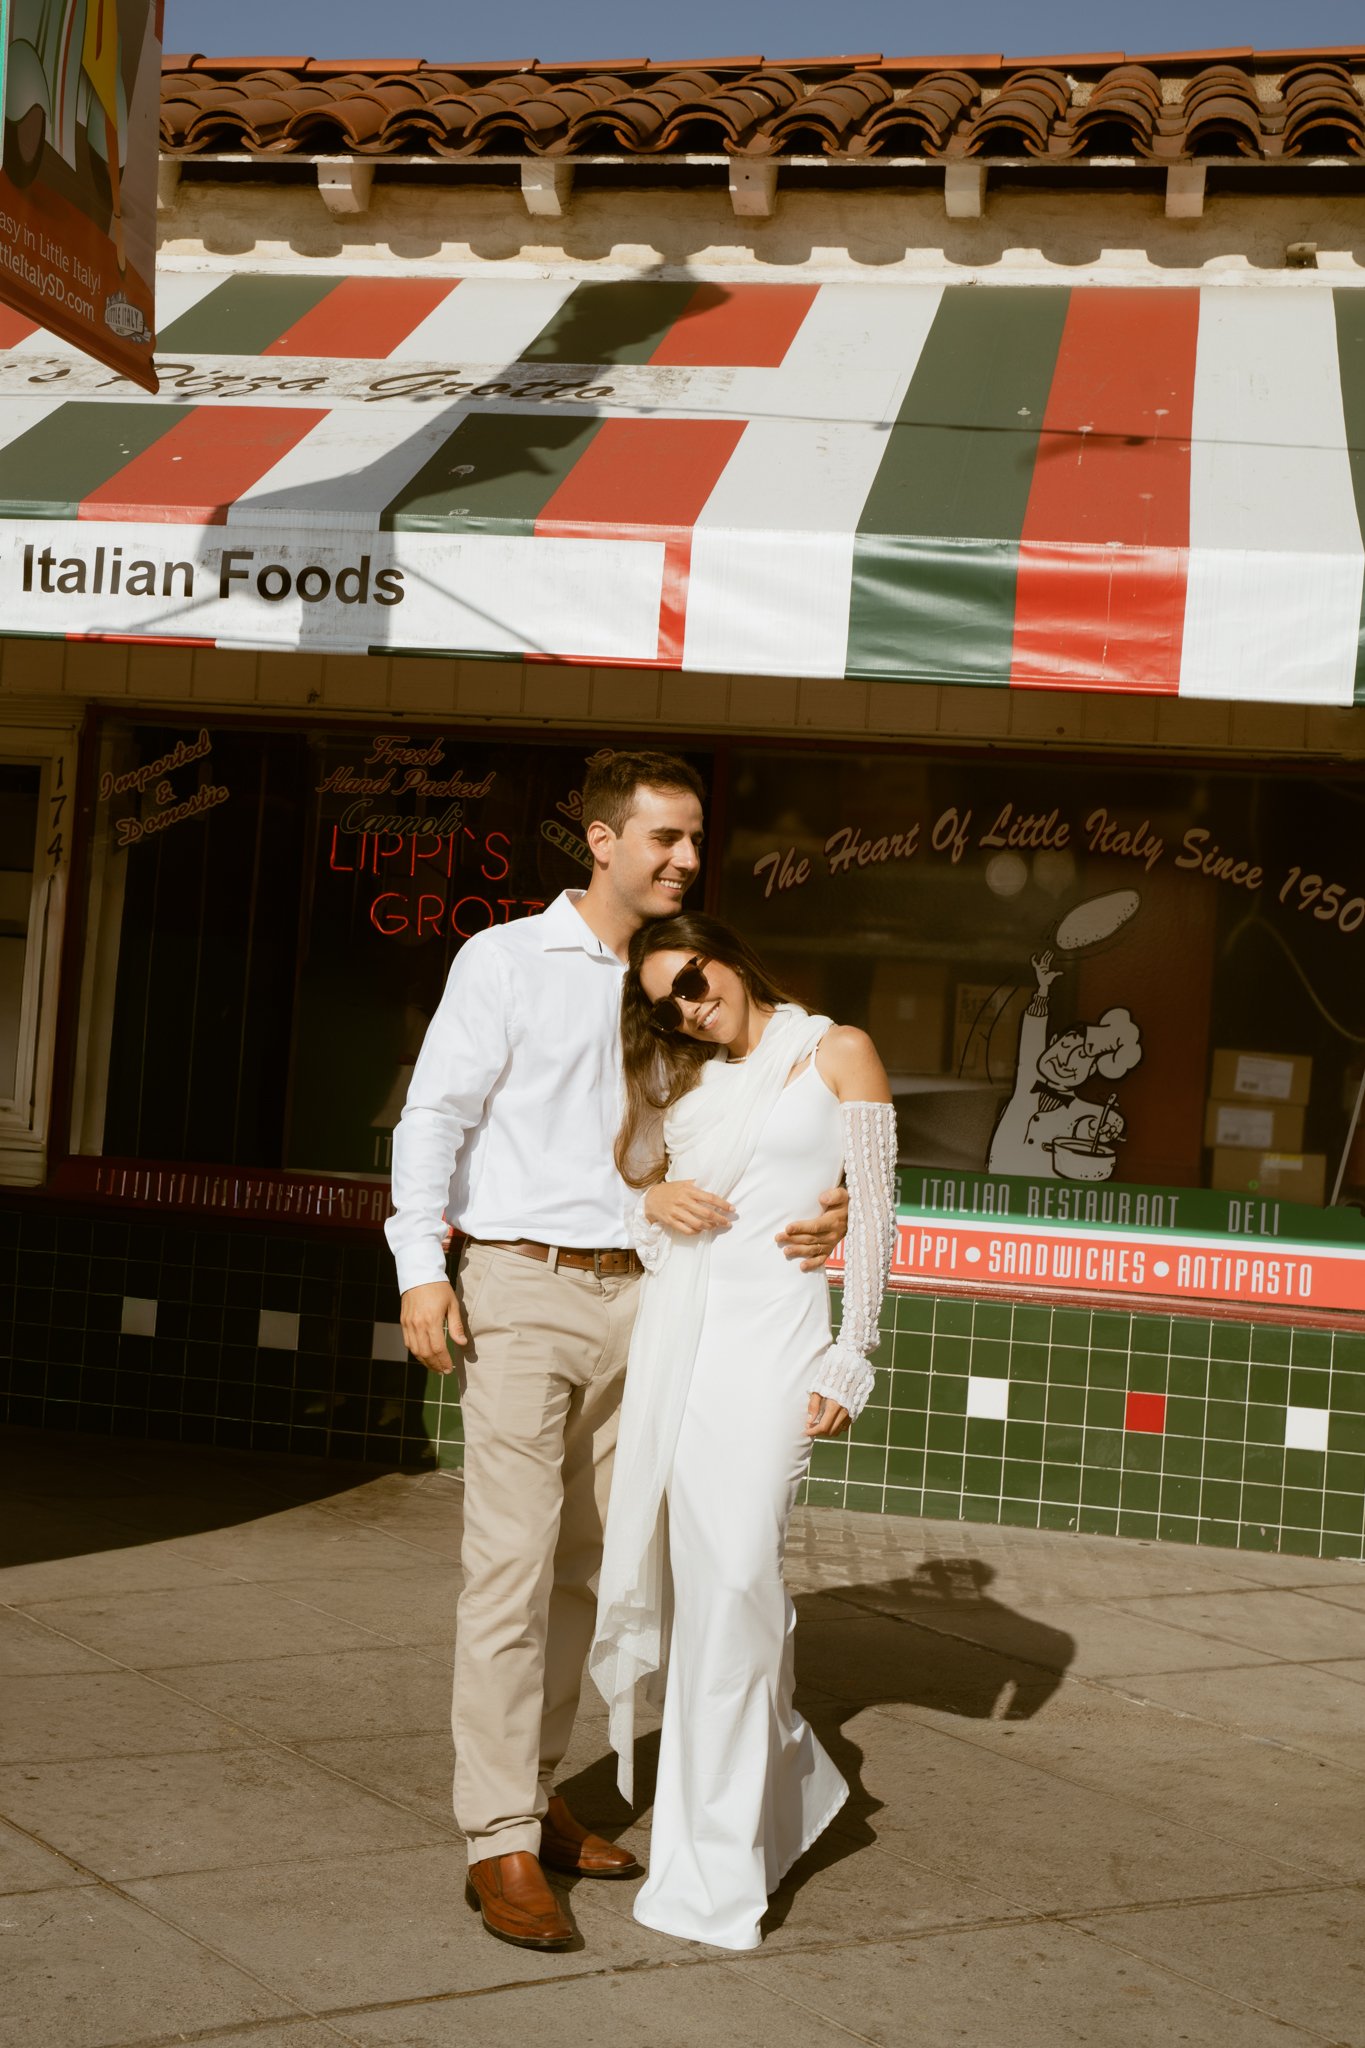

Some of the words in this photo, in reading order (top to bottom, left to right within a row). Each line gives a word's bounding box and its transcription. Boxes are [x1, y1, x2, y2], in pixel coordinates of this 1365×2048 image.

[23, 223, 36, 251] in
[40, 232, 70, 273] Little
[73, 256, 101, 296] Italy!
[121, 306, 139, 329] ITALY
[364, 370, 616, 402] Grotto
[22, 543, 196, 599] Italian
[218, 550, 406, 606] Foods
[99, 728, 213, 802] Imported
[364, 735, 446, 767] Fresh
[156, 780, 178, 805] &
[315, 766, 397, 794] Hand
[391, 769, 497, 798] Packed
[116, 784, 231, 847] Domestic
[340, 799, 464, 838] Cannoli
[753, 847, 811, 899] The
[824, 822, 920, 875] Heart
[931, 807, 973, 864] Of
[978, 802, 1070, 849] Little
[1085, 807, 1164, 873] Italy
[1174, 828, 1263, 889] Since
[1278, 866, 1365, 933] 1950
[919, 1177, 1010, 1216] ITALIAN
[1026, 1185, 1180, 1229] RESTAURANT
[1228, 1200, 1281, 1237] DELI
[988, 1239, 1146, 1285] SANDWICHES
[1176, 1253, 1313, 1298] ANTIPASTO
